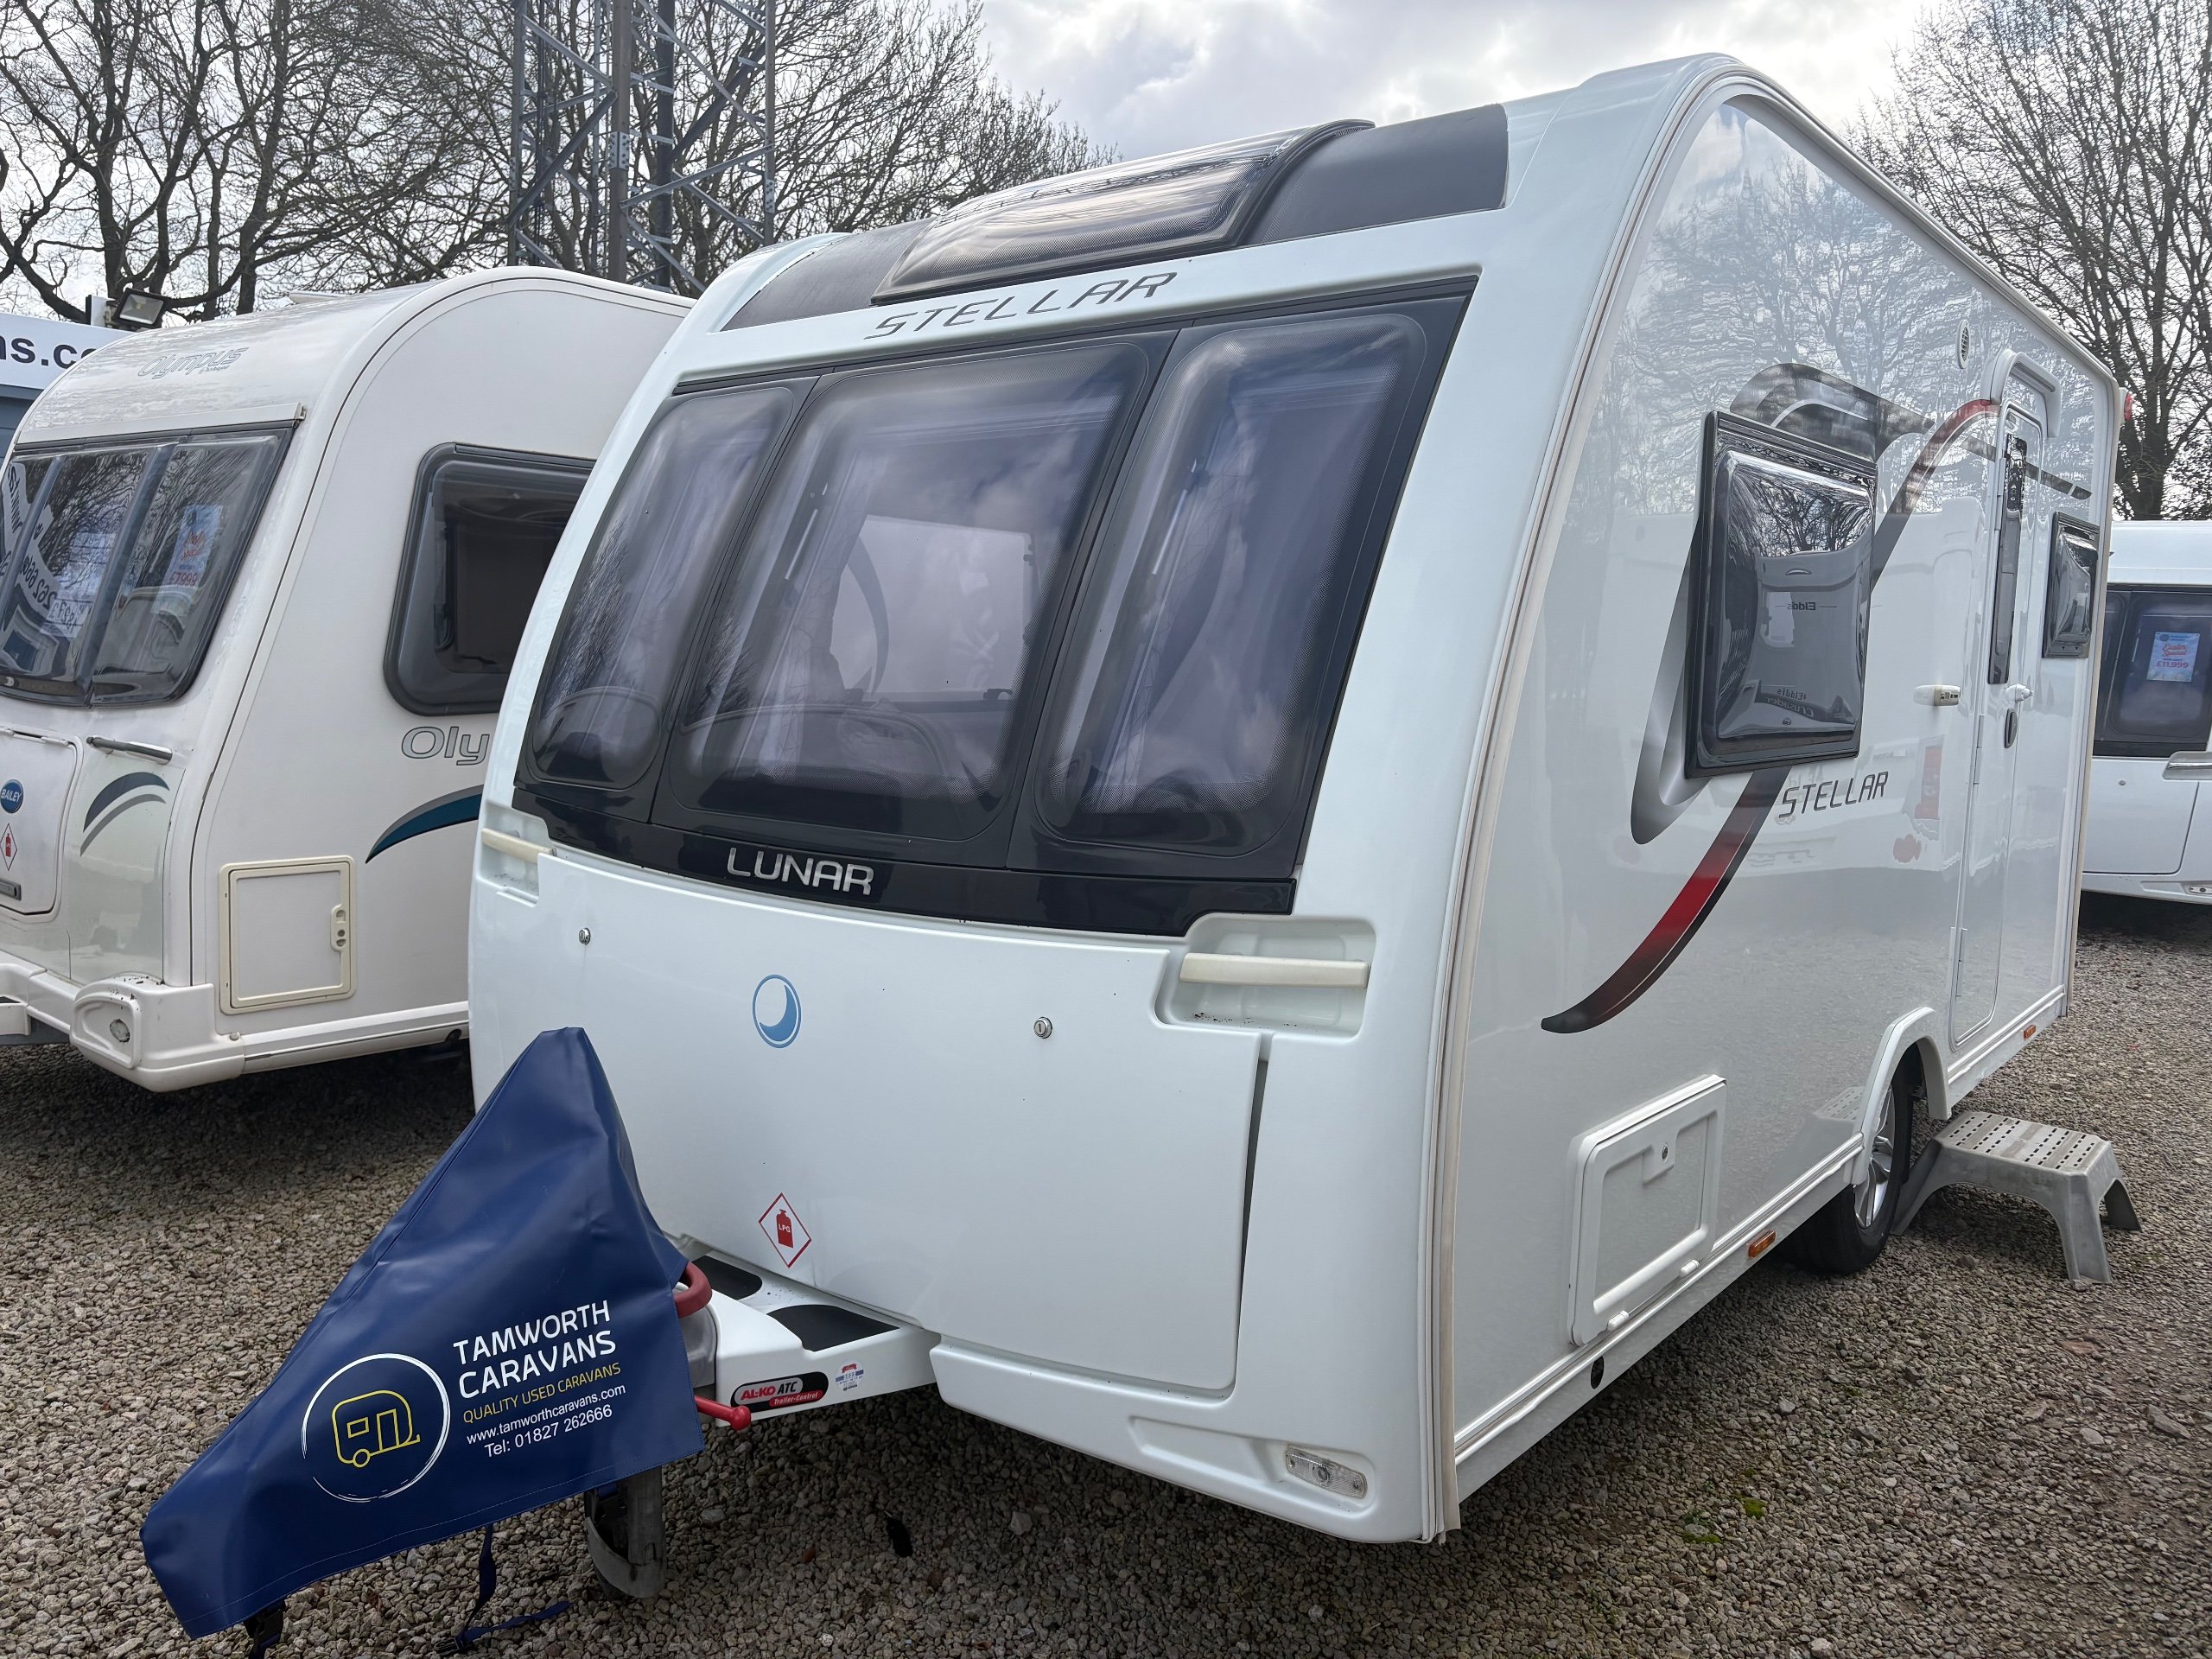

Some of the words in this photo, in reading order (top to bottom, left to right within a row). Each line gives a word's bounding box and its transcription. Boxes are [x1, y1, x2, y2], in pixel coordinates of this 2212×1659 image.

[863, 271, 1178, 340] STELLAR
[138, 347, 249, 379] Olympus
[1, 788, 22, 803] BAILEY
[1778, 771, 1889, 819] STELLAR
[727, 848, 874, 895] LUNAR
[779, 1223, 791, 1233] LPG
[453, 1300, 611, 1365] TAMWORTH
[459, 1330, 616, 1399] CARAVANS
[777, 1381, 799, 1395] ATC
[463, 1395, 518, 1423] QUALITY
[522, 1383, 556, 1405] USED
[557, 1362, 621, 1393] CARAVANS
[467, 1384, 626, 1445] www.tamworthcaravans.com
[774, 1392, 819, 1406] Trailer-Control
[485, 1439, 511, 1458] Tel:
[514, 1422, 559, 1448] 01827
[563, 1404, 613, 1433] 262666
